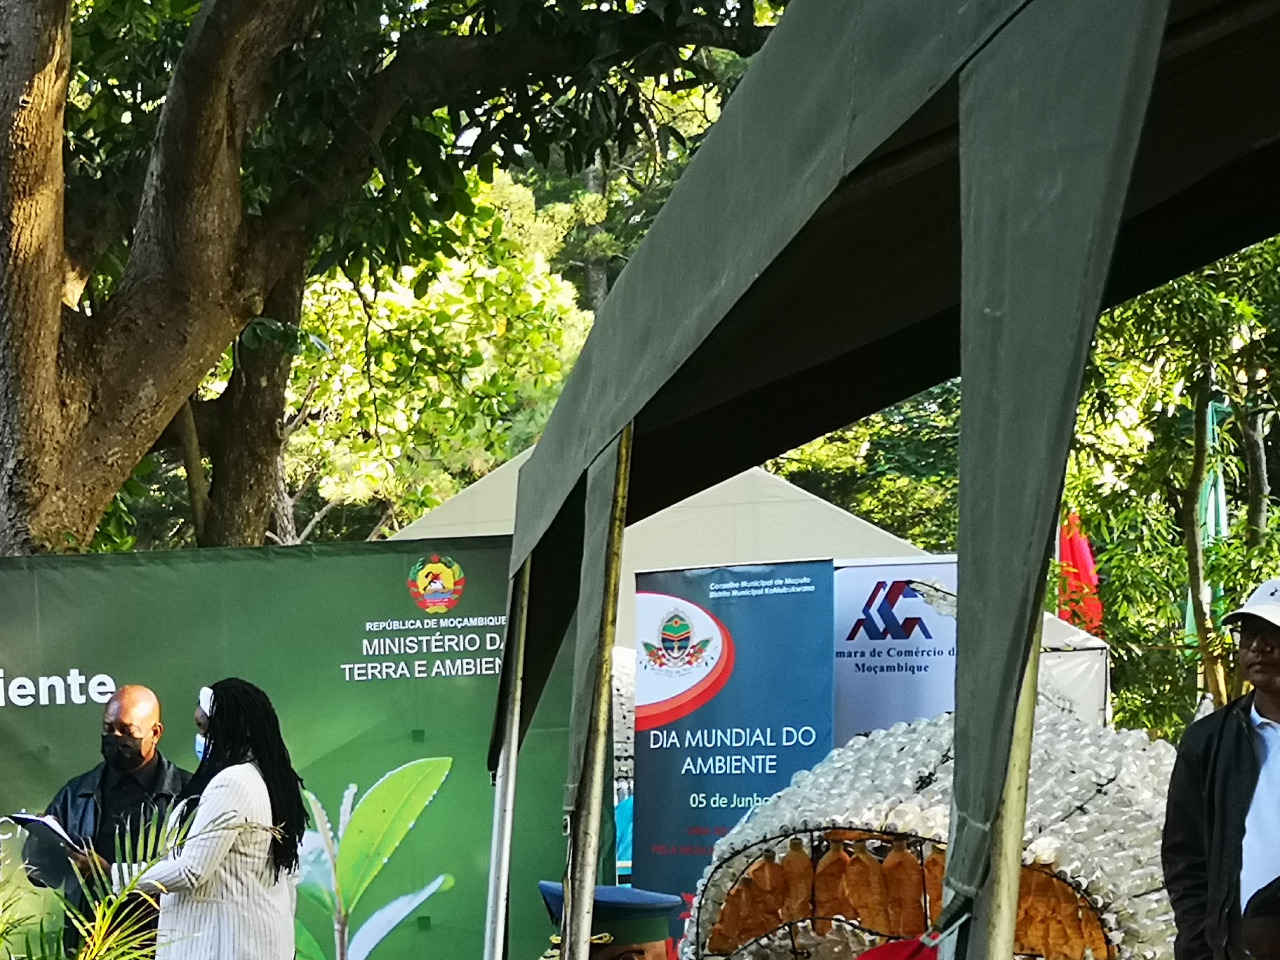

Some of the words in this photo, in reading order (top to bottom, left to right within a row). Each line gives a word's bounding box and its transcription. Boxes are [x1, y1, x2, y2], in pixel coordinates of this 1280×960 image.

[365, 619, 422, 632] REPÚBLICA
[423, 618, 438, 629] DE
[439, 615, 507, 629] MOÇAMBIQUE
[362, 632, 481, 656] MINISTÉRIO
[835, 649, 866, 659] mara
[869, 647, 883, 659] de
[886, 646, 944, 659] Comércio
[947, 646, 956, 657] d
[340, 660, 411, 682] TERRA
[414, 660, 428, 678] E
[431, 656, 503, 677] AMBIEN
[854, 662, 930, 675] Moçambique
[650, 730, 681, 749] DIA
[684, 727, 777, 748] MUNDIAL
[782, 726, 817, 746] DO
[681, 755, 777, 775] AMBIENTE
[689, 793, 707, 808] 05
[710, 793, 728, 808] de
